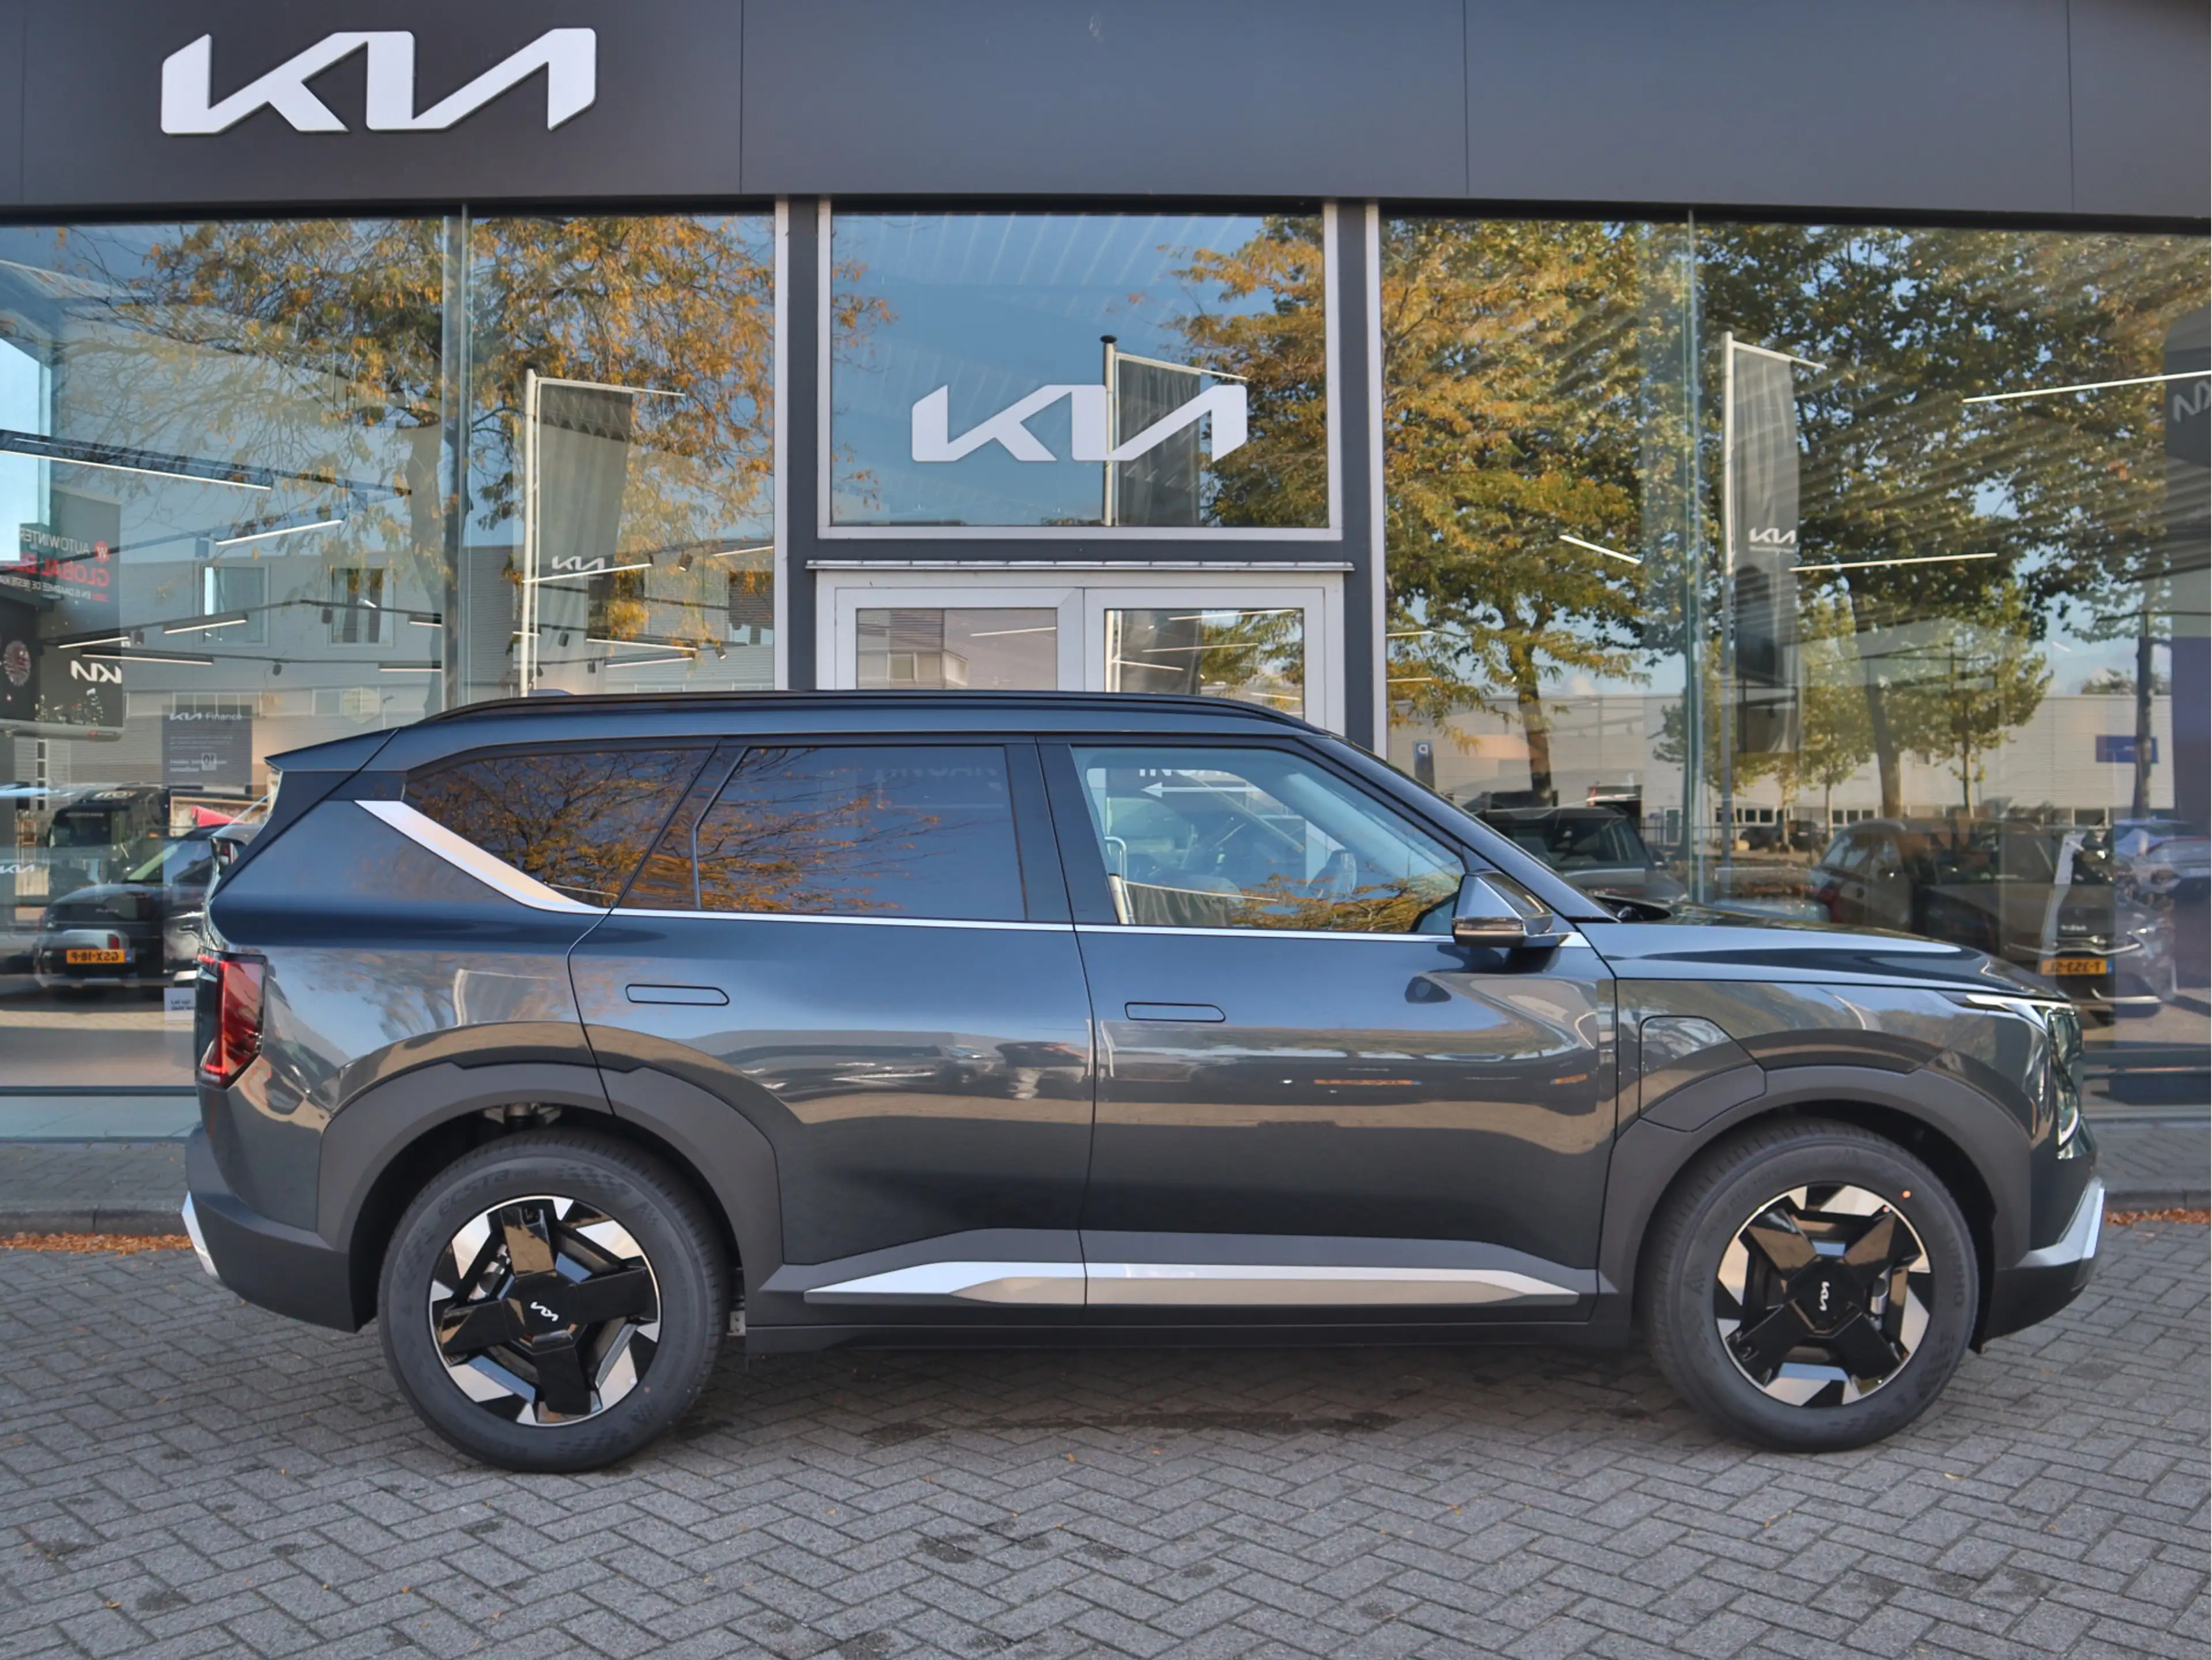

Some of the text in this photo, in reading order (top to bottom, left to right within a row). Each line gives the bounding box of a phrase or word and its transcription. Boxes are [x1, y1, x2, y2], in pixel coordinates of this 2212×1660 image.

[161, 28, 596, 135] KIA
[911, 384, 1247, 462] KIA
[1748, 527, 1796, 545] KIA
[552, 555, 605, 571] KIA
[169, 712, 202, 720] KIA
